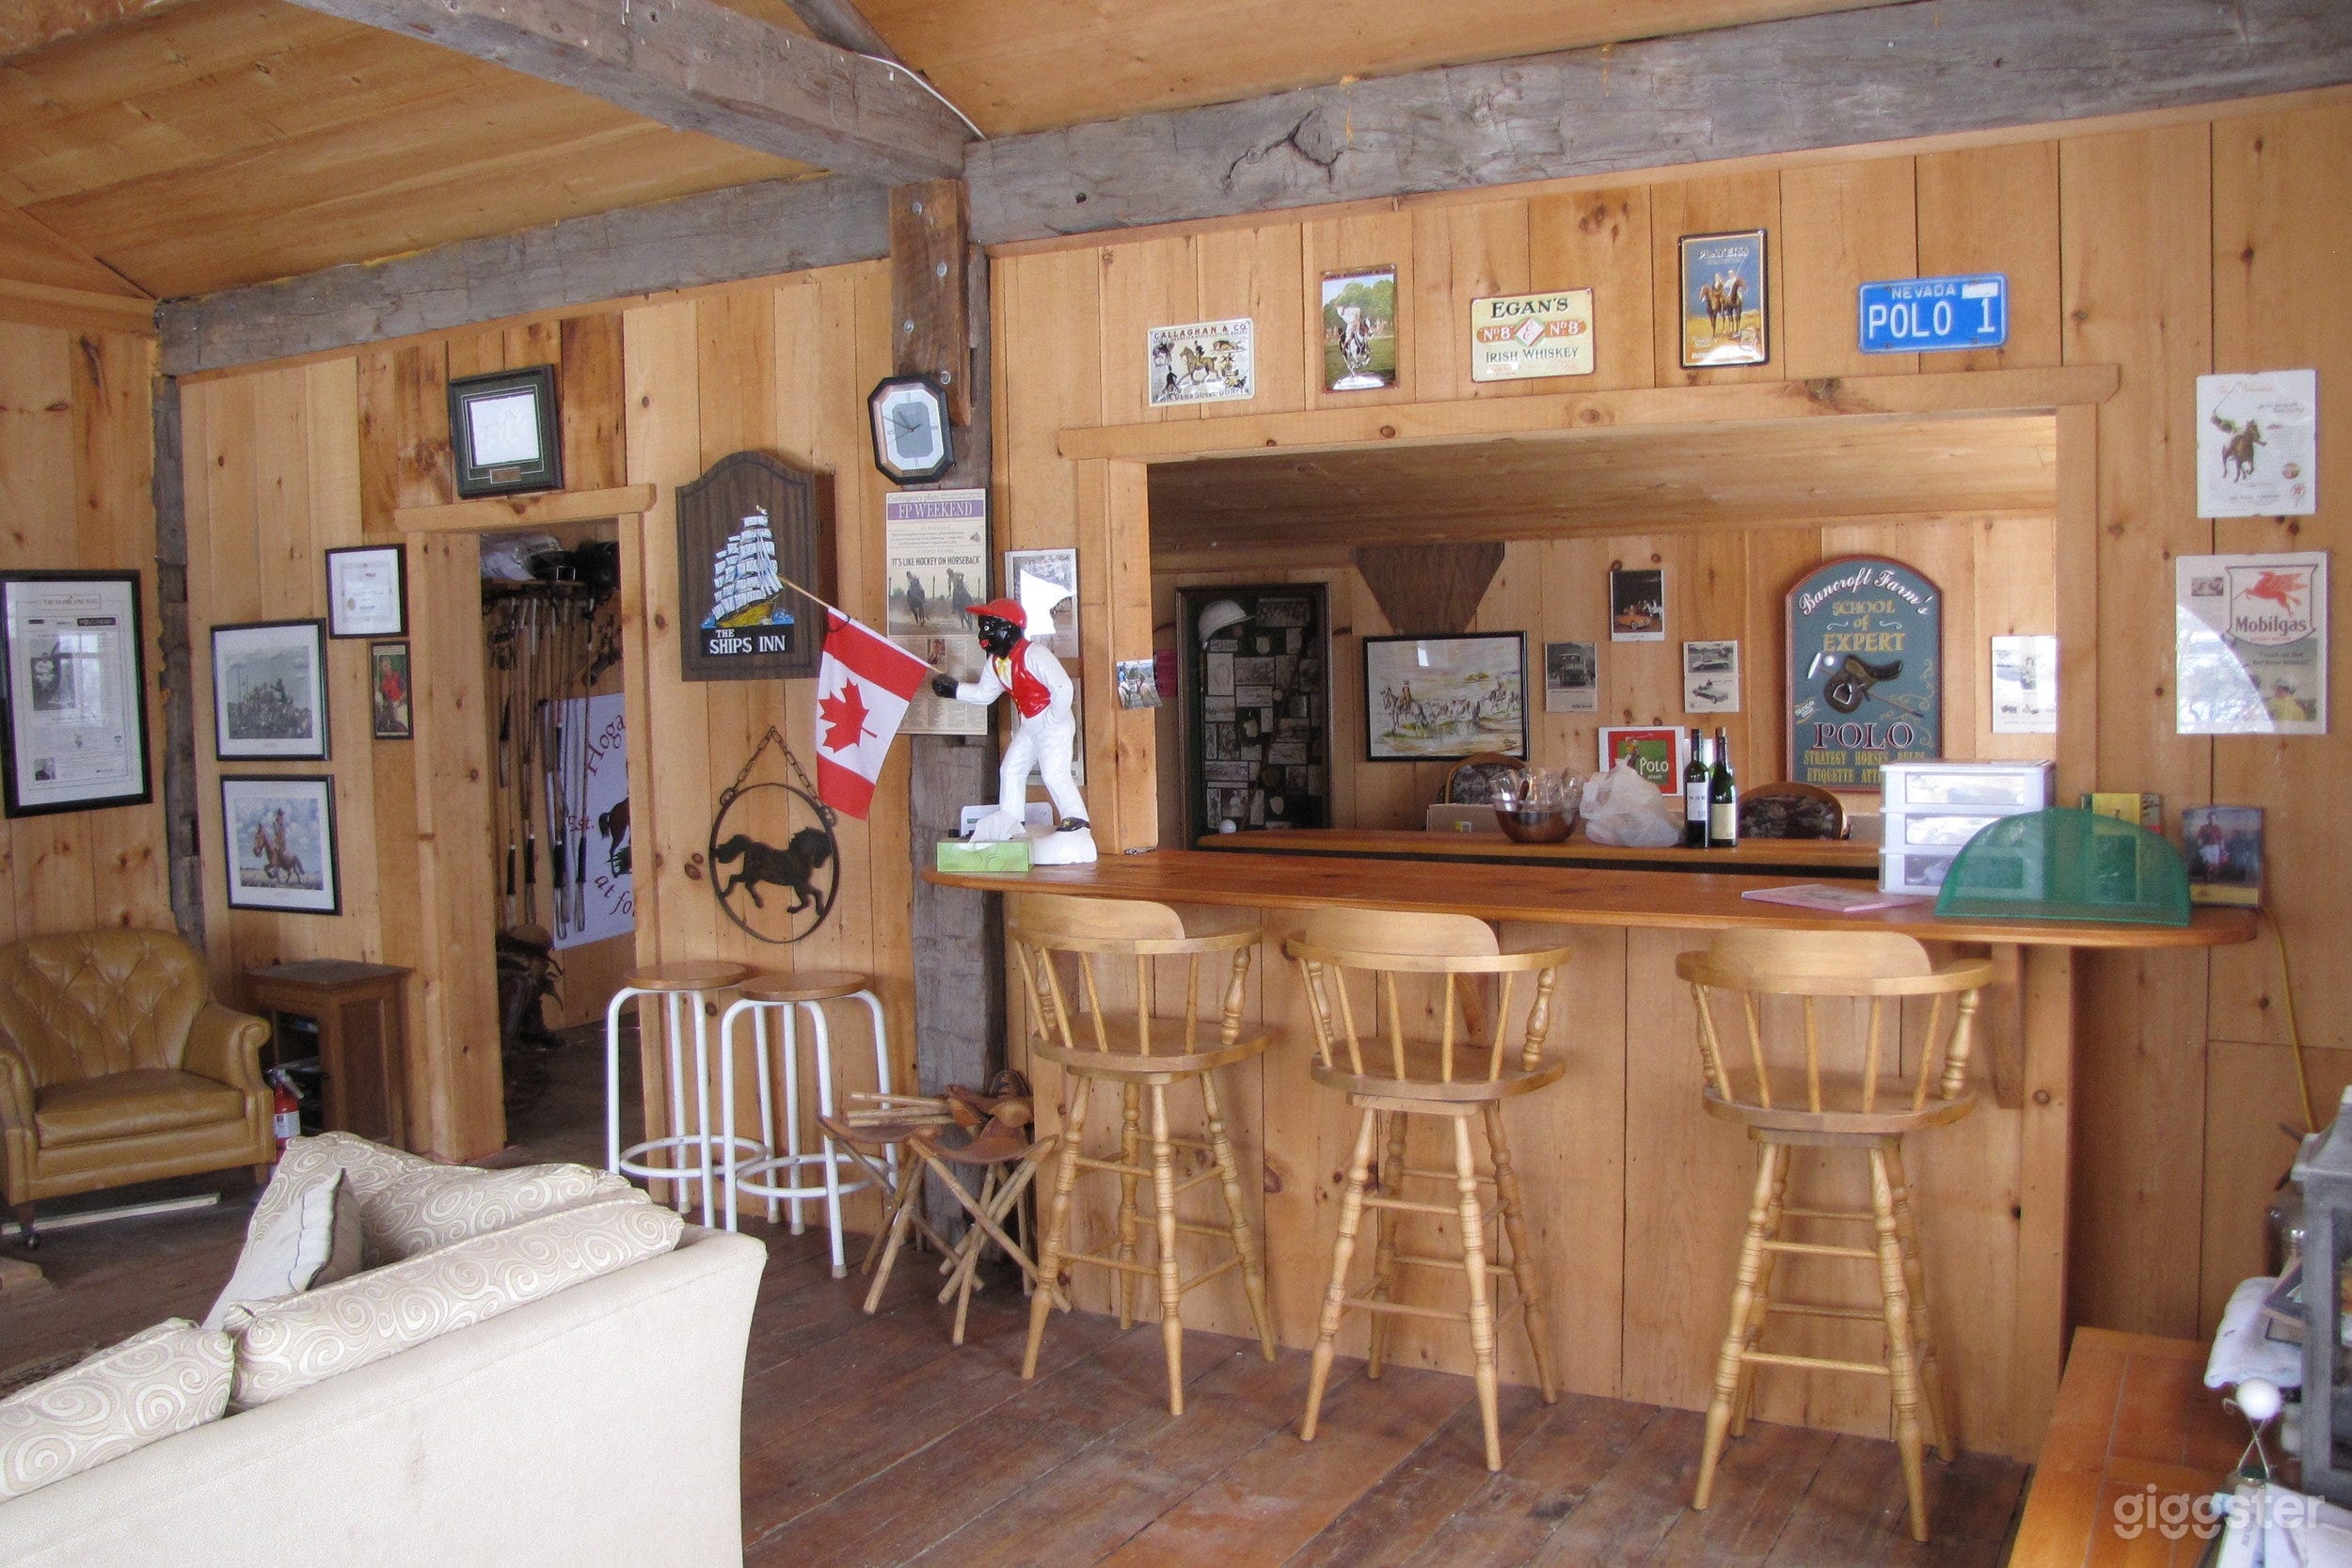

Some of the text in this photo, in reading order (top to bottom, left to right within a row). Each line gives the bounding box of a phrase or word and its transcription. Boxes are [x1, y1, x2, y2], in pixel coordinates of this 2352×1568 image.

[1891, 284, 1957, 299] NEVADA
[1490, 297, 1569, 319] EGAN'S
[1868, 297, 1995, 340] POLO 1
[1154, 326, 1217, 340] CALLAGHAN
[1486, 347, 1579, 363] IRISH WHISKEY
[898, 501, 973, 518] FP WEEKEND
[903, 557, 914, 566] LIKE
[916, 557, 937, 565] HOCKEY
[938, 556, 946, 564] ON
[1798, 567, 1932, 615] Bancroft Farm's
[1832, 600, 1895, 616] SCHOOL
[1853, 614, 1870, 630] of
[2235, 615, 2308, 636] Mobilgas
[716, 629, 735, 638] THE
[1822, 632, 1905, 652] EXPERT
[709, 635, 786, 654] SHIPS INN
[1813, 721, 1915, 750] POLO
[1640, 756, 1669, 775] POLO
[1804, 751, 1847, 766] STRATEGY
[1855, 751, 1888, 766] HORSES
[1806, 768, 1854, 784] ETIQUETTE
[610, 890, 636, 917] fo
